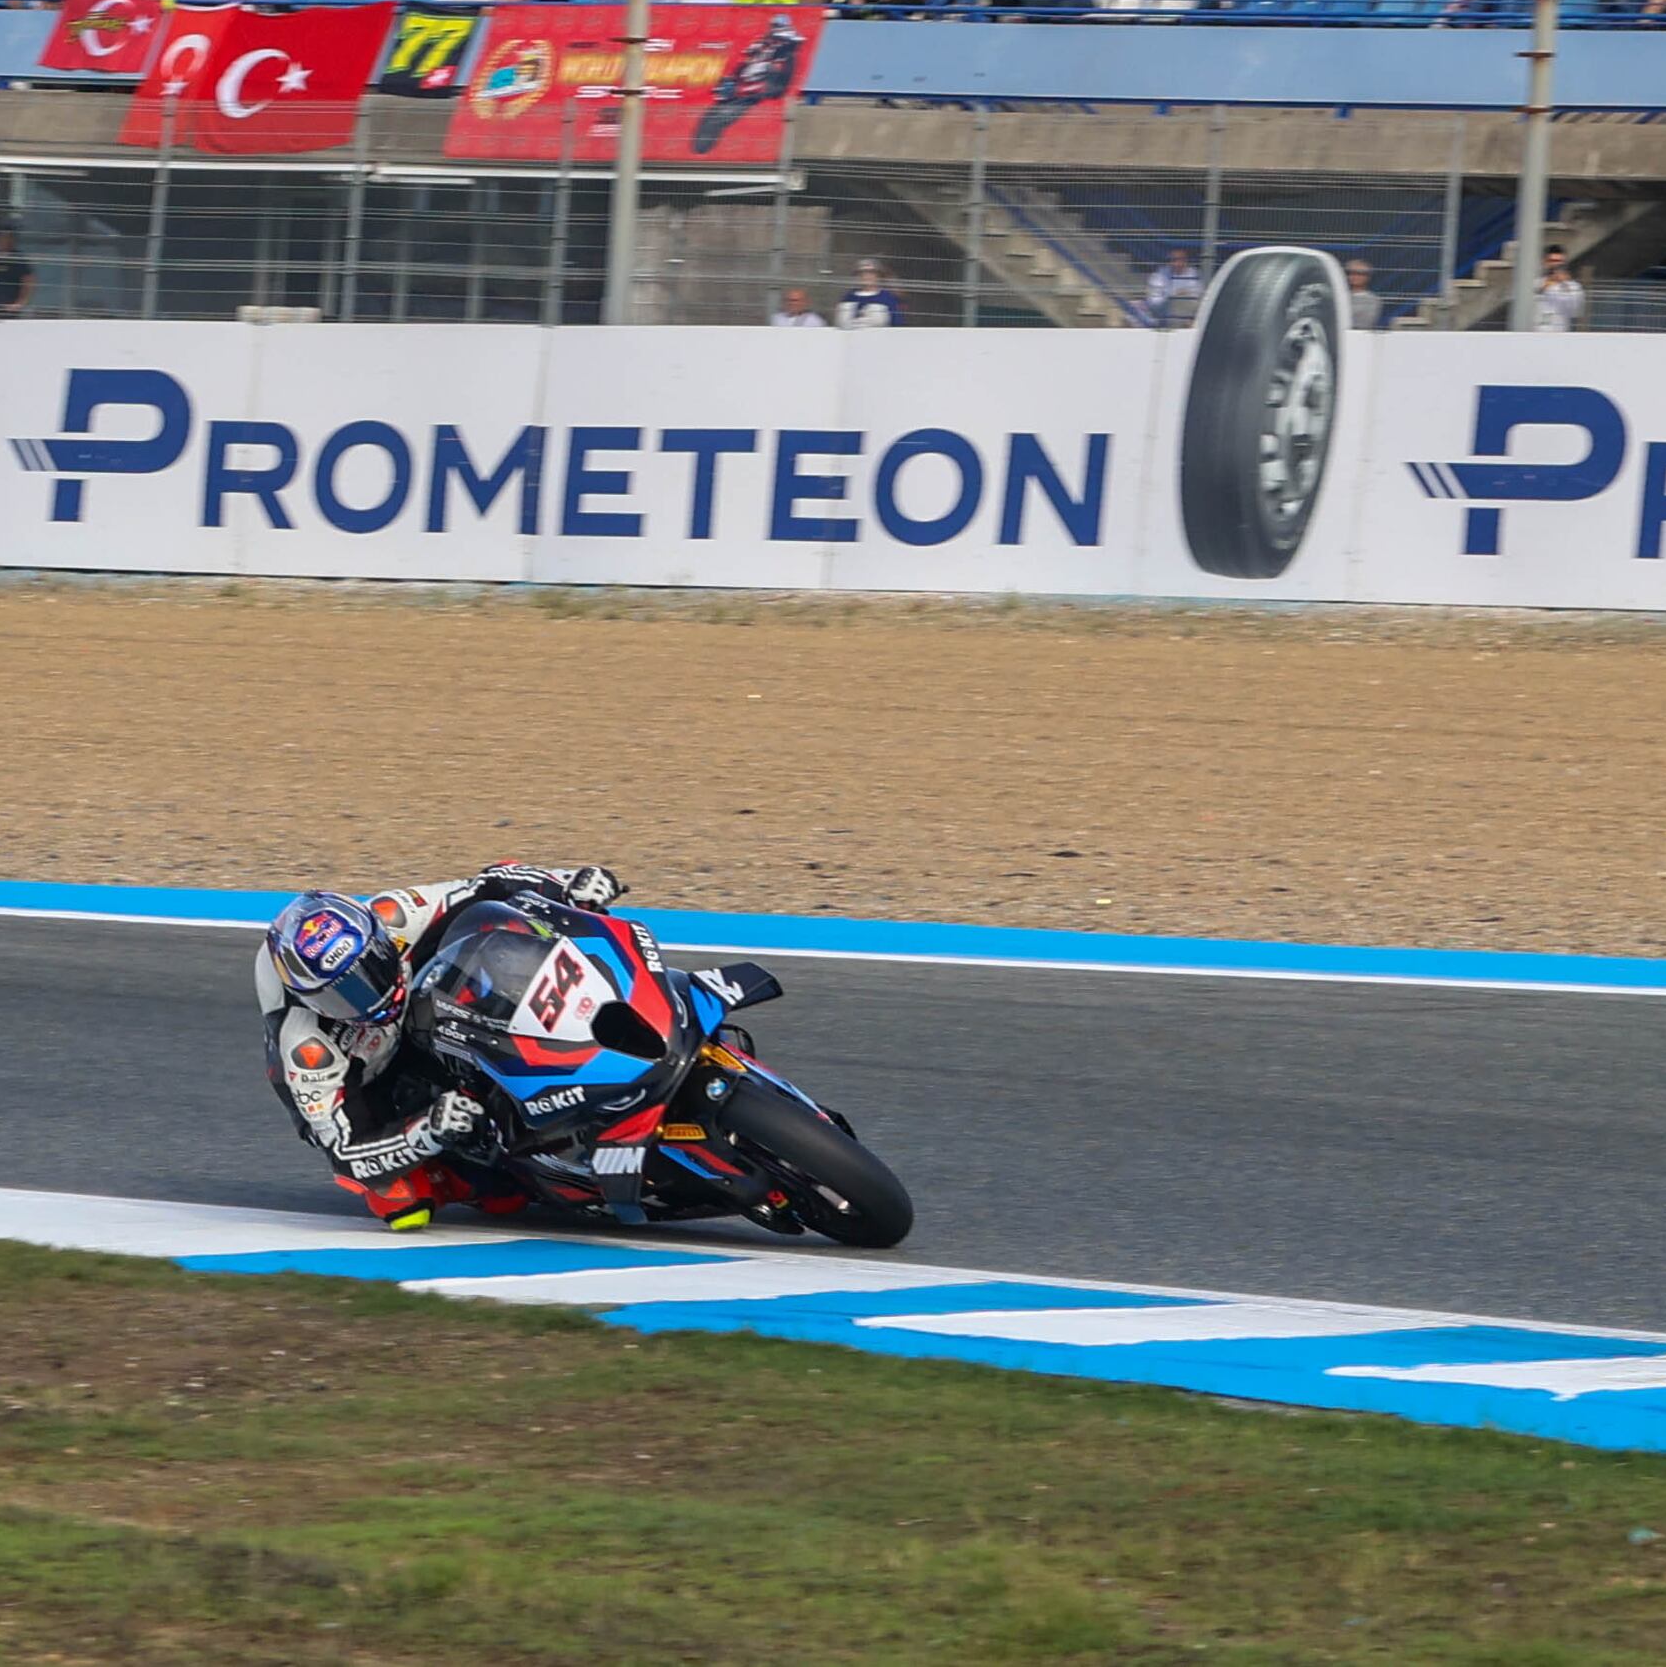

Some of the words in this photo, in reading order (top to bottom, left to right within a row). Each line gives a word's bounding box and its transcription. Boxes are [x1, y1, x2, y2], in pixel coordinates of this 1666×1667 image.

[385, 13, 478, 78] 77
[22, 368, 1109, 555] PROMETEON
[529, 949, 584, 1033] 54
